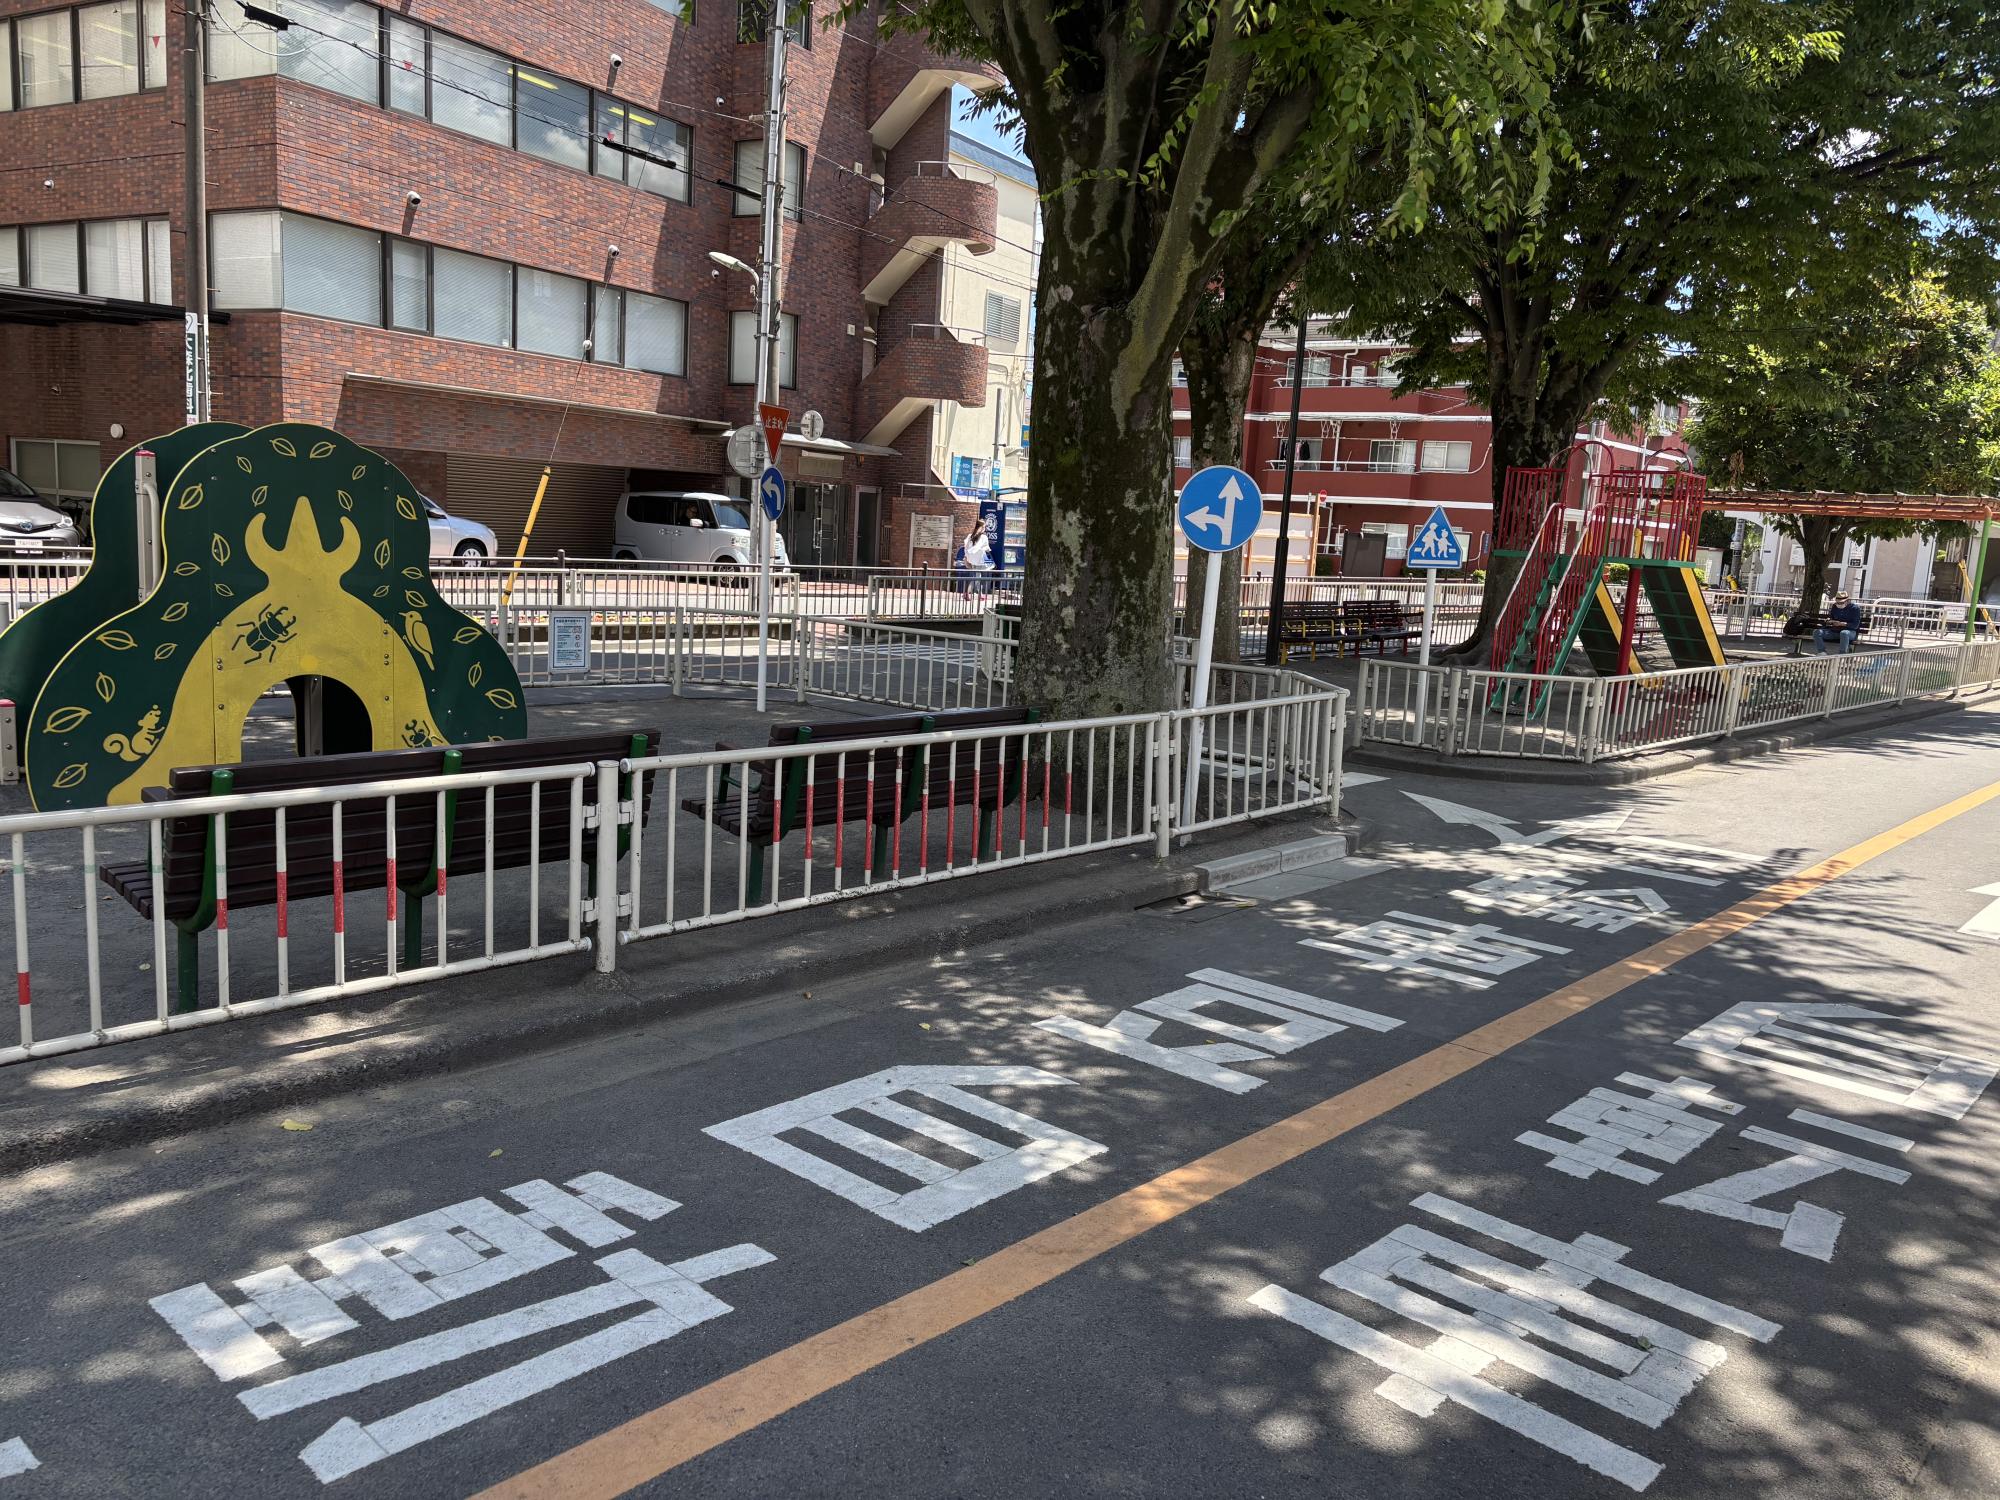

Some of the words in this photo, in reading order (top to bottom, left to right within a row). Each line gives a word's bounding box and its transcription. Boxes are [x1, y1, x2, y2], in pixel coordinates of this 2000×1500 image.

[765, 415, 783, 430] 止まれ
[1246, 1001, 2000, 1492] 自転車
